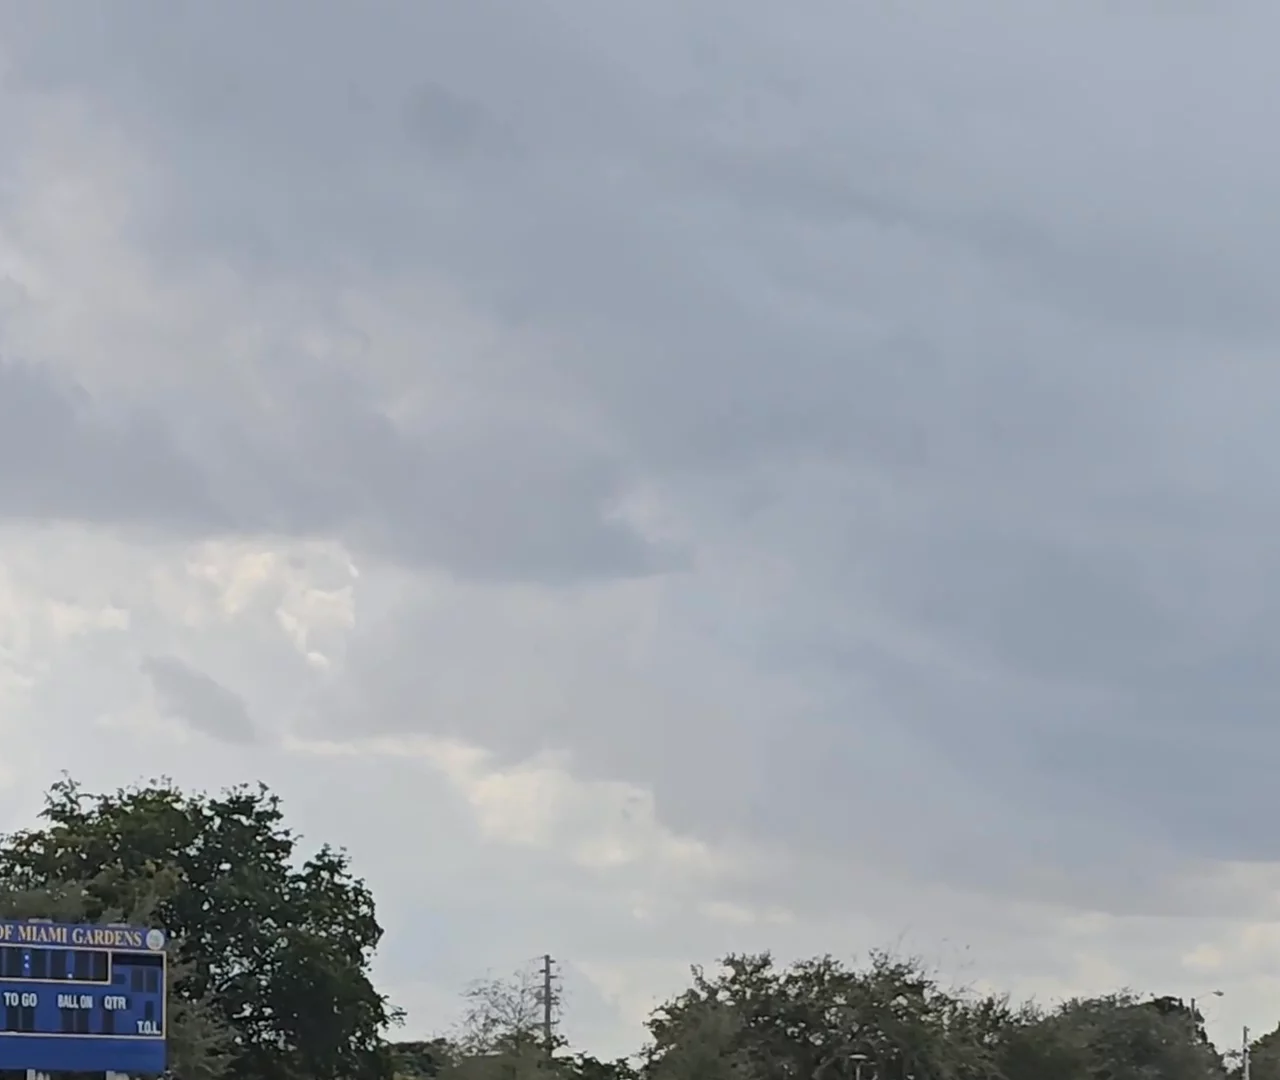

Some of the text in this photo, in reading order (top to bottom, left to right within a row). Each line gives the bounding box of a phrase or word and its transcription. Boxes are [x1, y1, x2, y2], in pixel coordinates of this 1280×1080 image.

[18, 925, 67, 944] MIAMI
[72, 927, 142, 947] GARDENS
[4, 992, 37, 1008] TO GO
[58, 994, 93, 1009] BALL ON
[104, 996, 127, 1011] QTR
